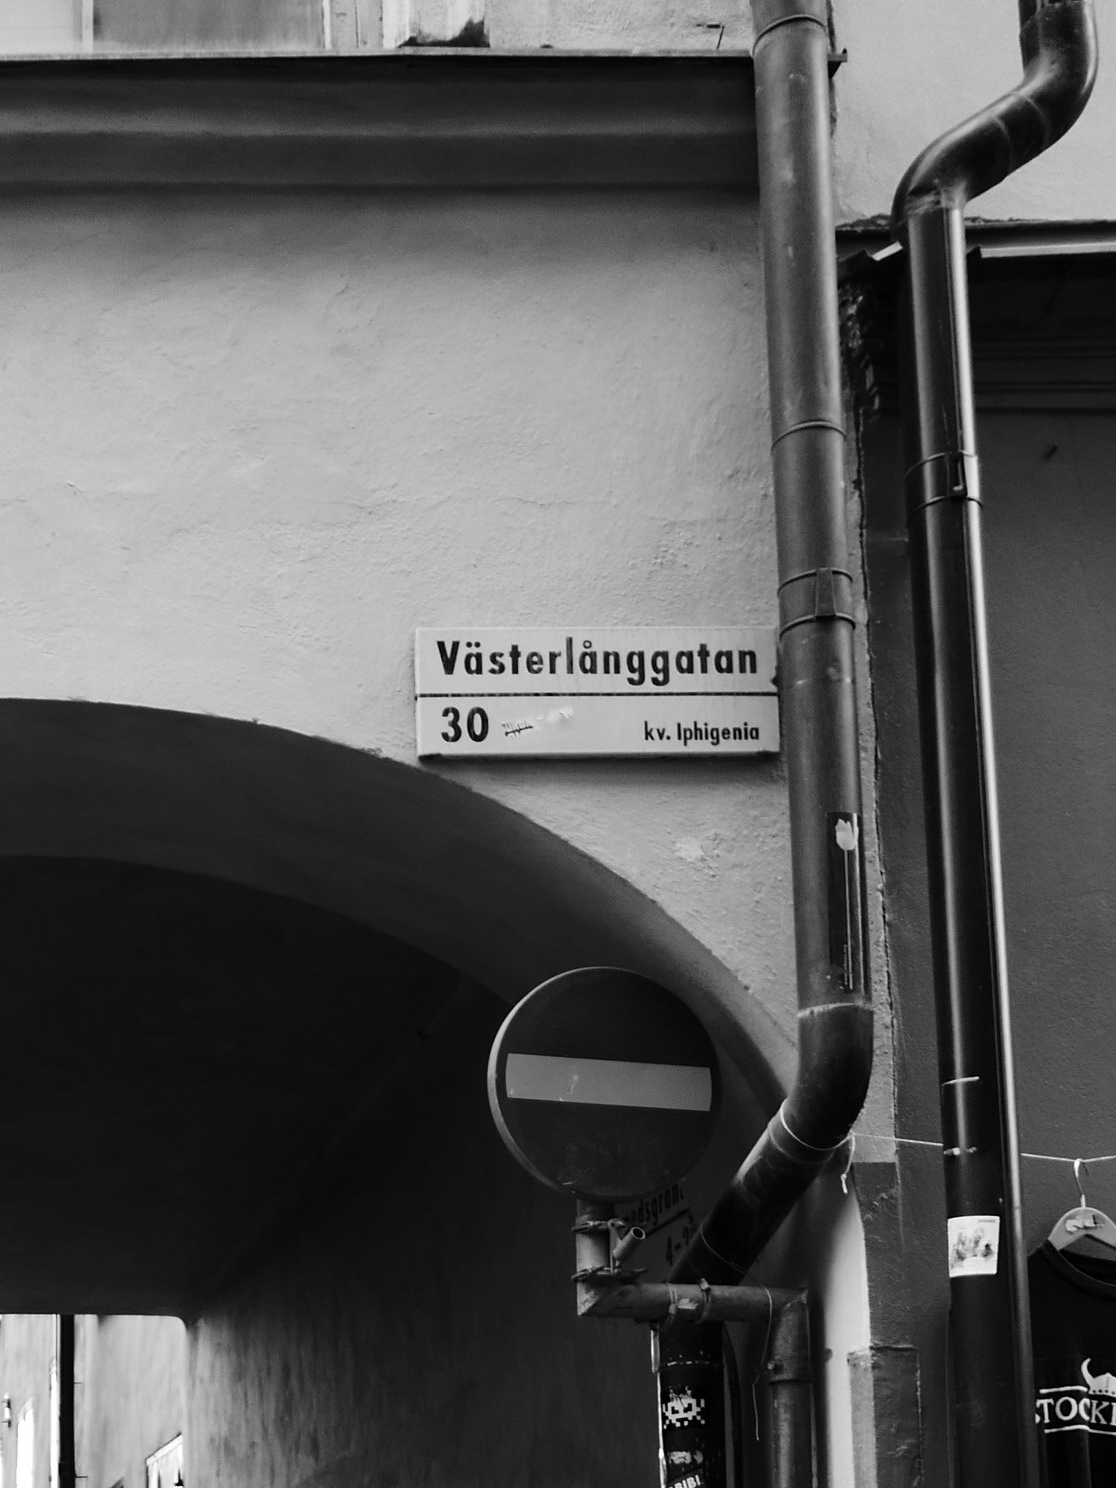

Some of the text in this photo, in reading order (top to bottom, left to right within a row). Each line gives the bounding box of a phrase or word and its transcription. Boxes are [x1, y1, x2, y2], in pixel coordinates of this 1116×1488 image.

[437, 636, 758, 687] Västerlånggatan
[441, 706, 489, 743] 30
[644, 721, 760, 746] kv. Iphigenia
[1035, 1396, 1116, 1426] TOCK
